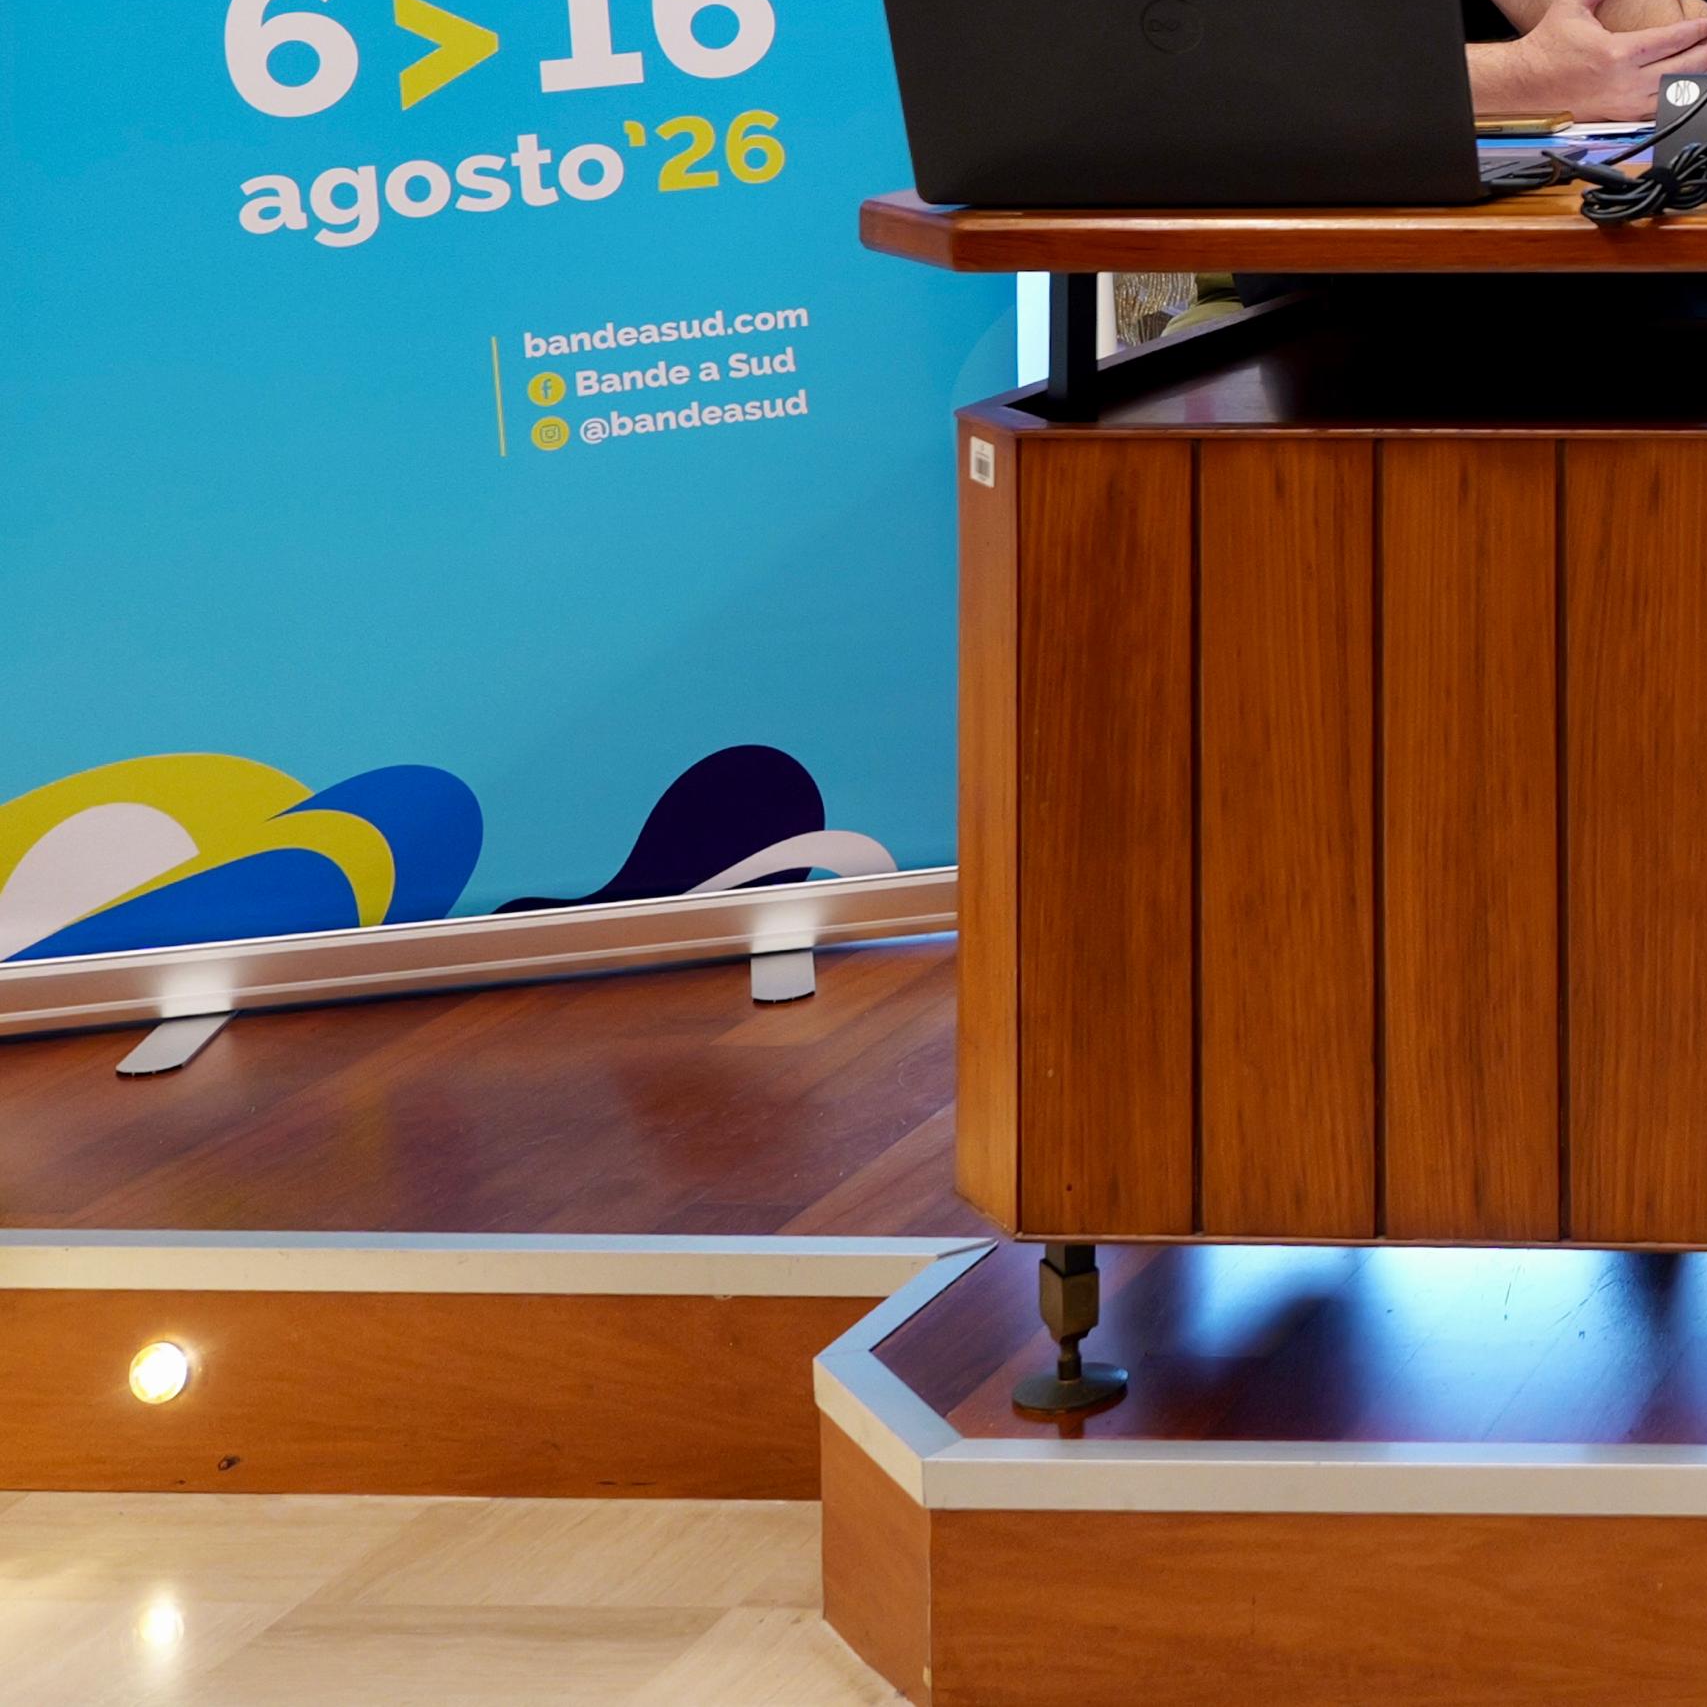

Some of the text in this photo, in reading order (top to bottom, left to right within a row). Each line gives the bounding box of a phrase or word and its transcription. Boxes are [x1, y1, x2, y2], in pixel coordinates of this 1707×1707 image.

[523, 301, 810, 360] bandeasud.com
[574, 346, 797, 400] Bande a Sud
[579, 390, 810, 448] @bandeasud
